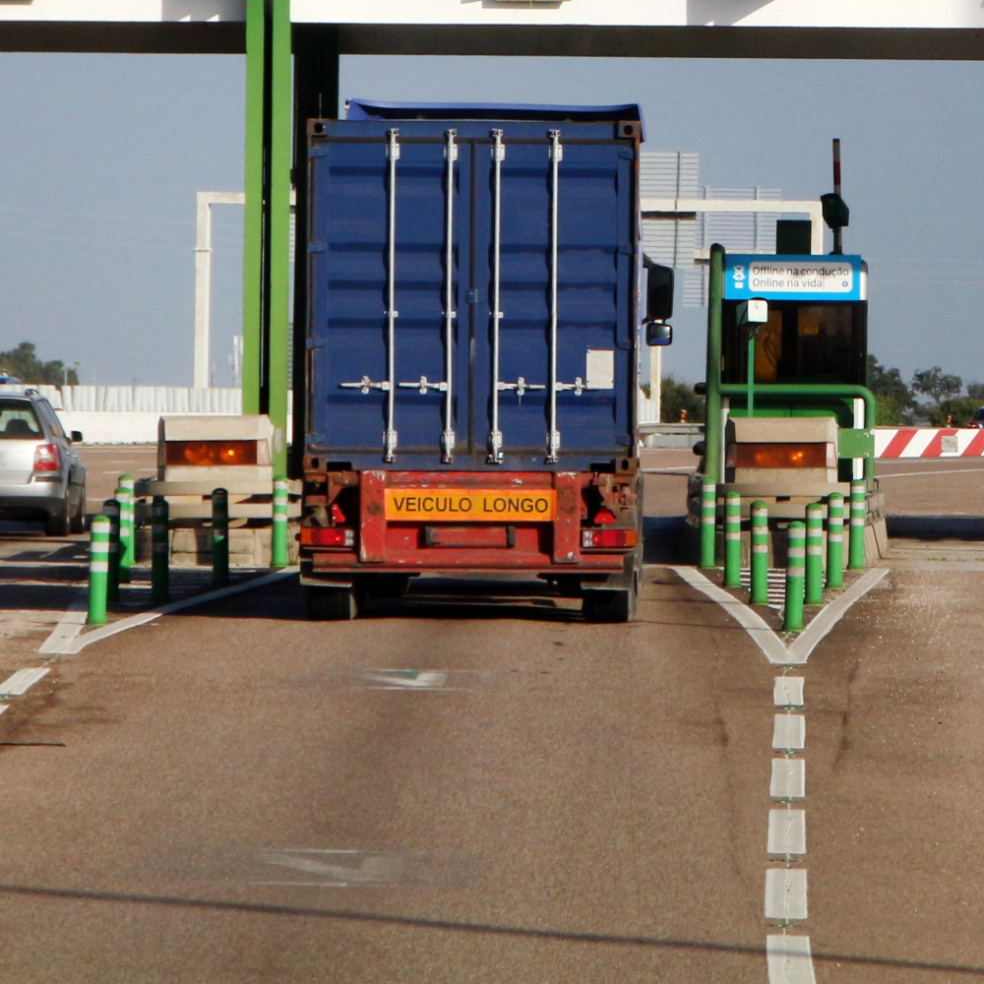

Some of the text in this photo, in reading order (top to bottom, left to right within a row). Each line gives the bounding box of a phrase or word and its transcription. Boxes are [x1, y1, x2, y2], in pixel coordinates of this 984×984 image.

[752, 265, 784, 276] Offline
[787, 267, 799, 276] na
[752, 278, 823, 288] Online na vida
[393, 497, 549, 514] VEICULO LONGO
